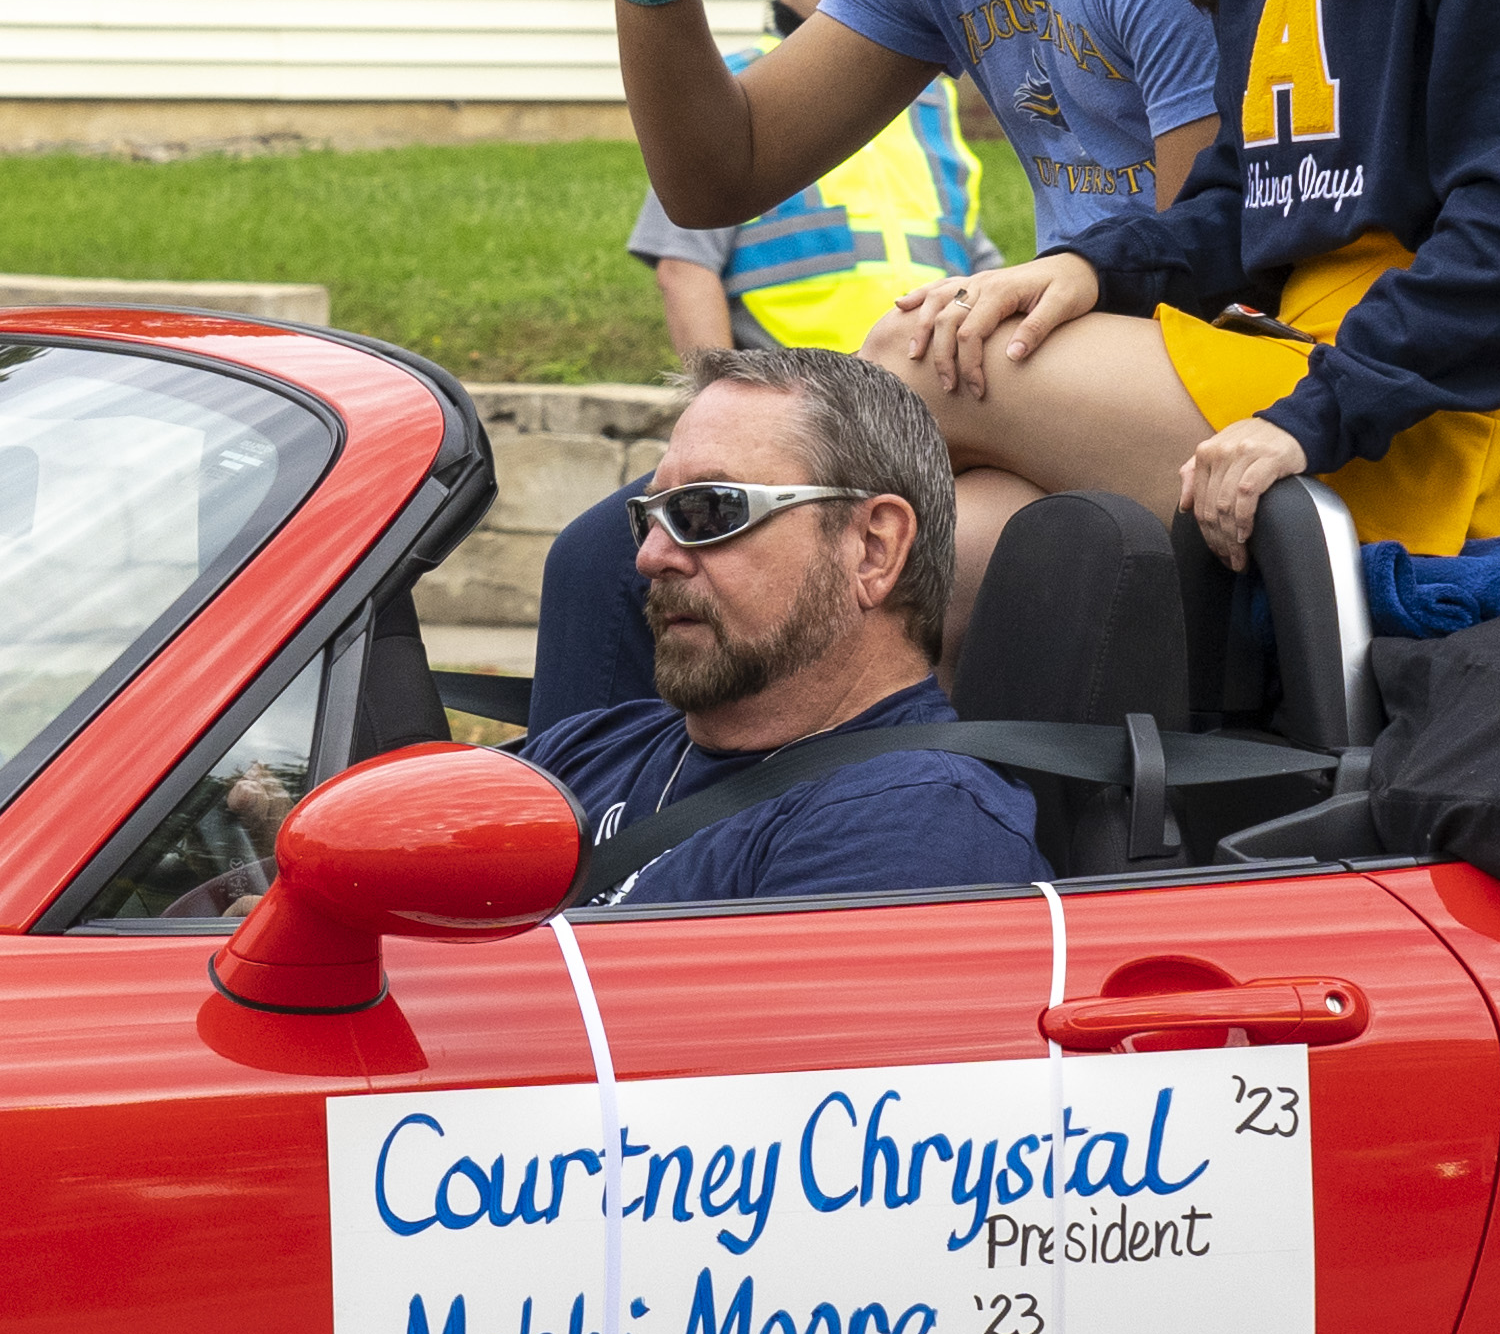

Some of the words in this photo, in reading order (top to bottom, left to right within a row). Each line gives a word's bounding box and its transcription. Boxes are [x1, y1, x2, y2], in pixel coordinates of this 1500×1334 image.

[1298, 153, 1364, 213] Days
[374, 1112, 782, 1255] Courtney
[799, 1087, 1211, 1253] Chrystal
[1231, 1075, 1301, 1138] '23
[984, 1203, 1213, 1269] President
